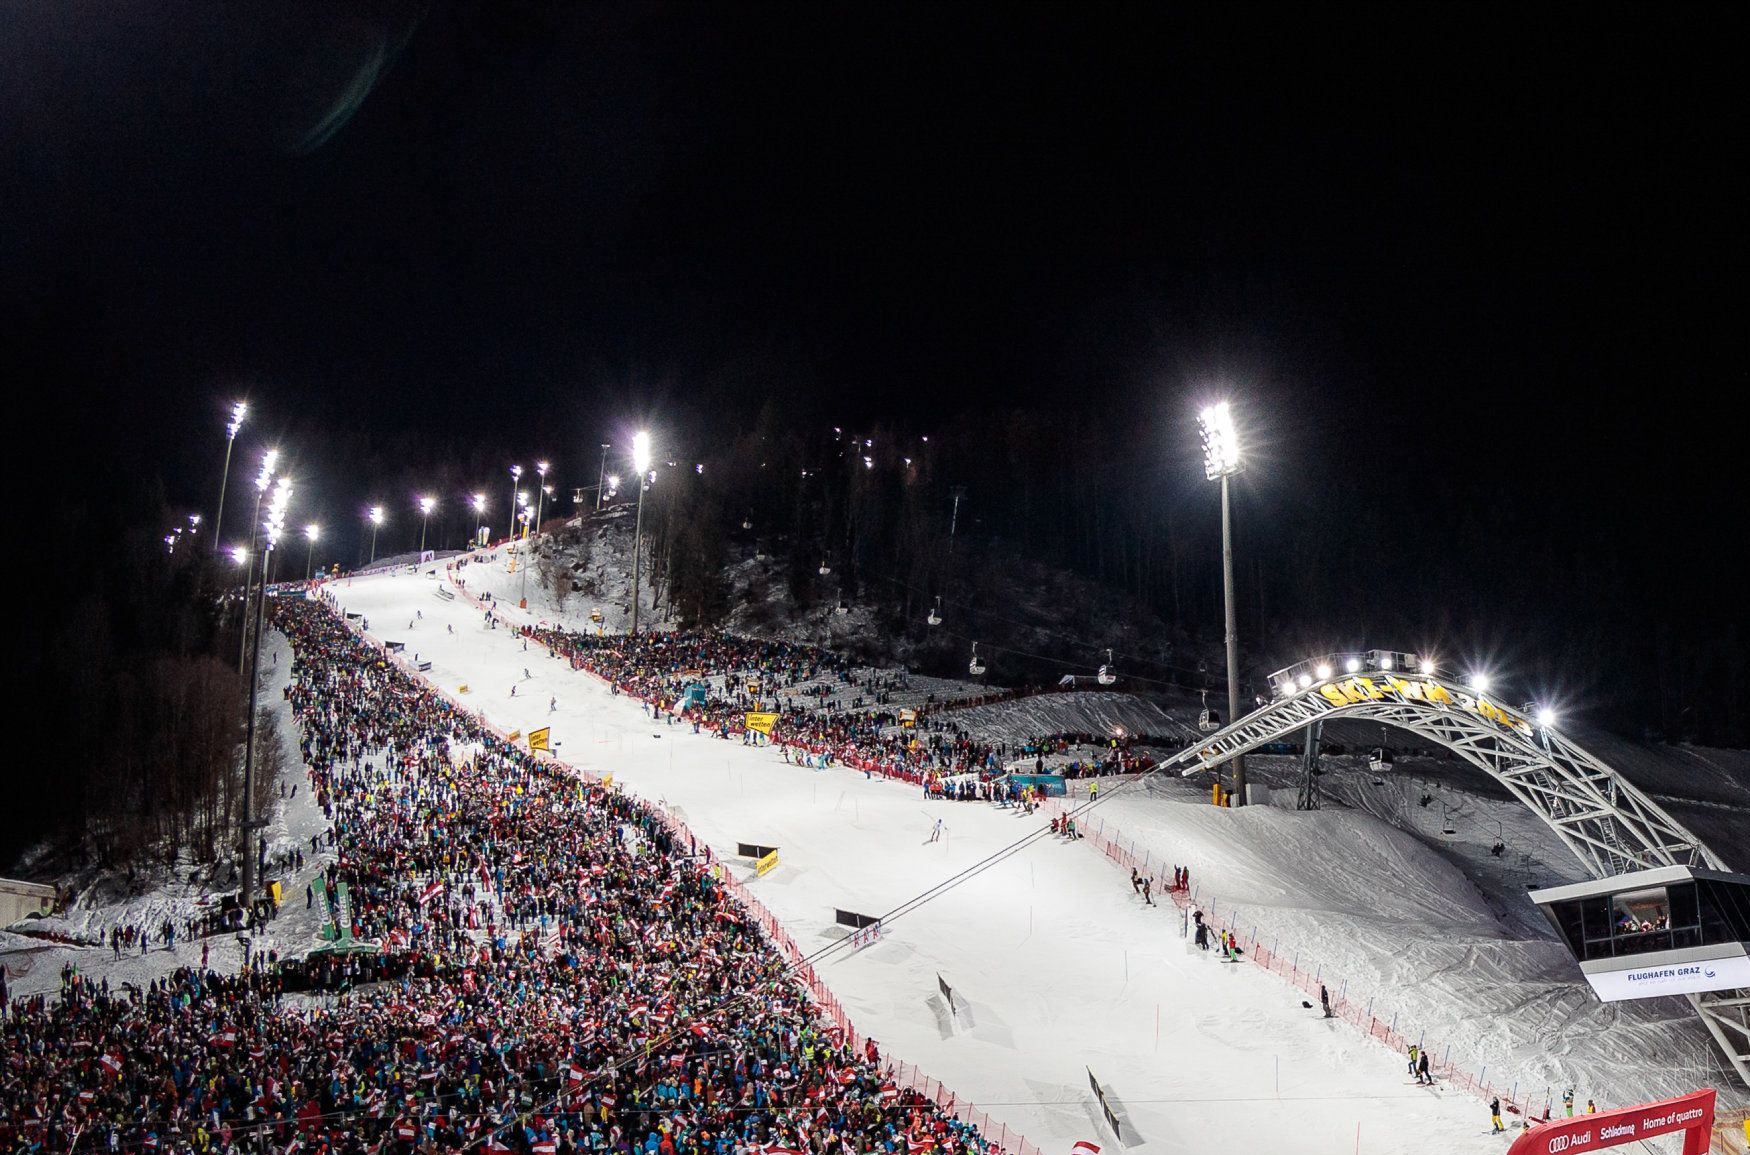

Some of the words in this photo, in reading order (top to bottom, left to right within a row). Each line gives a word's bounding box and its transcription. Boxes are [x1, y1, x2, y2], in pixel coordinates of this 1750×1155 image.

[1628, 969, 1675, 982] FLUGHAFEN
[1677, 966, 1701, 977] GRAZ
[1570, 1131, 1591, 1147] Audi
[1600, 1124, 1635, 1141] Schladming
[1643, 1116, 1666, 1130] Home
[1667, 1113, 1676, 1124] of
[1676, 1107, 1703, 1124] quattro
